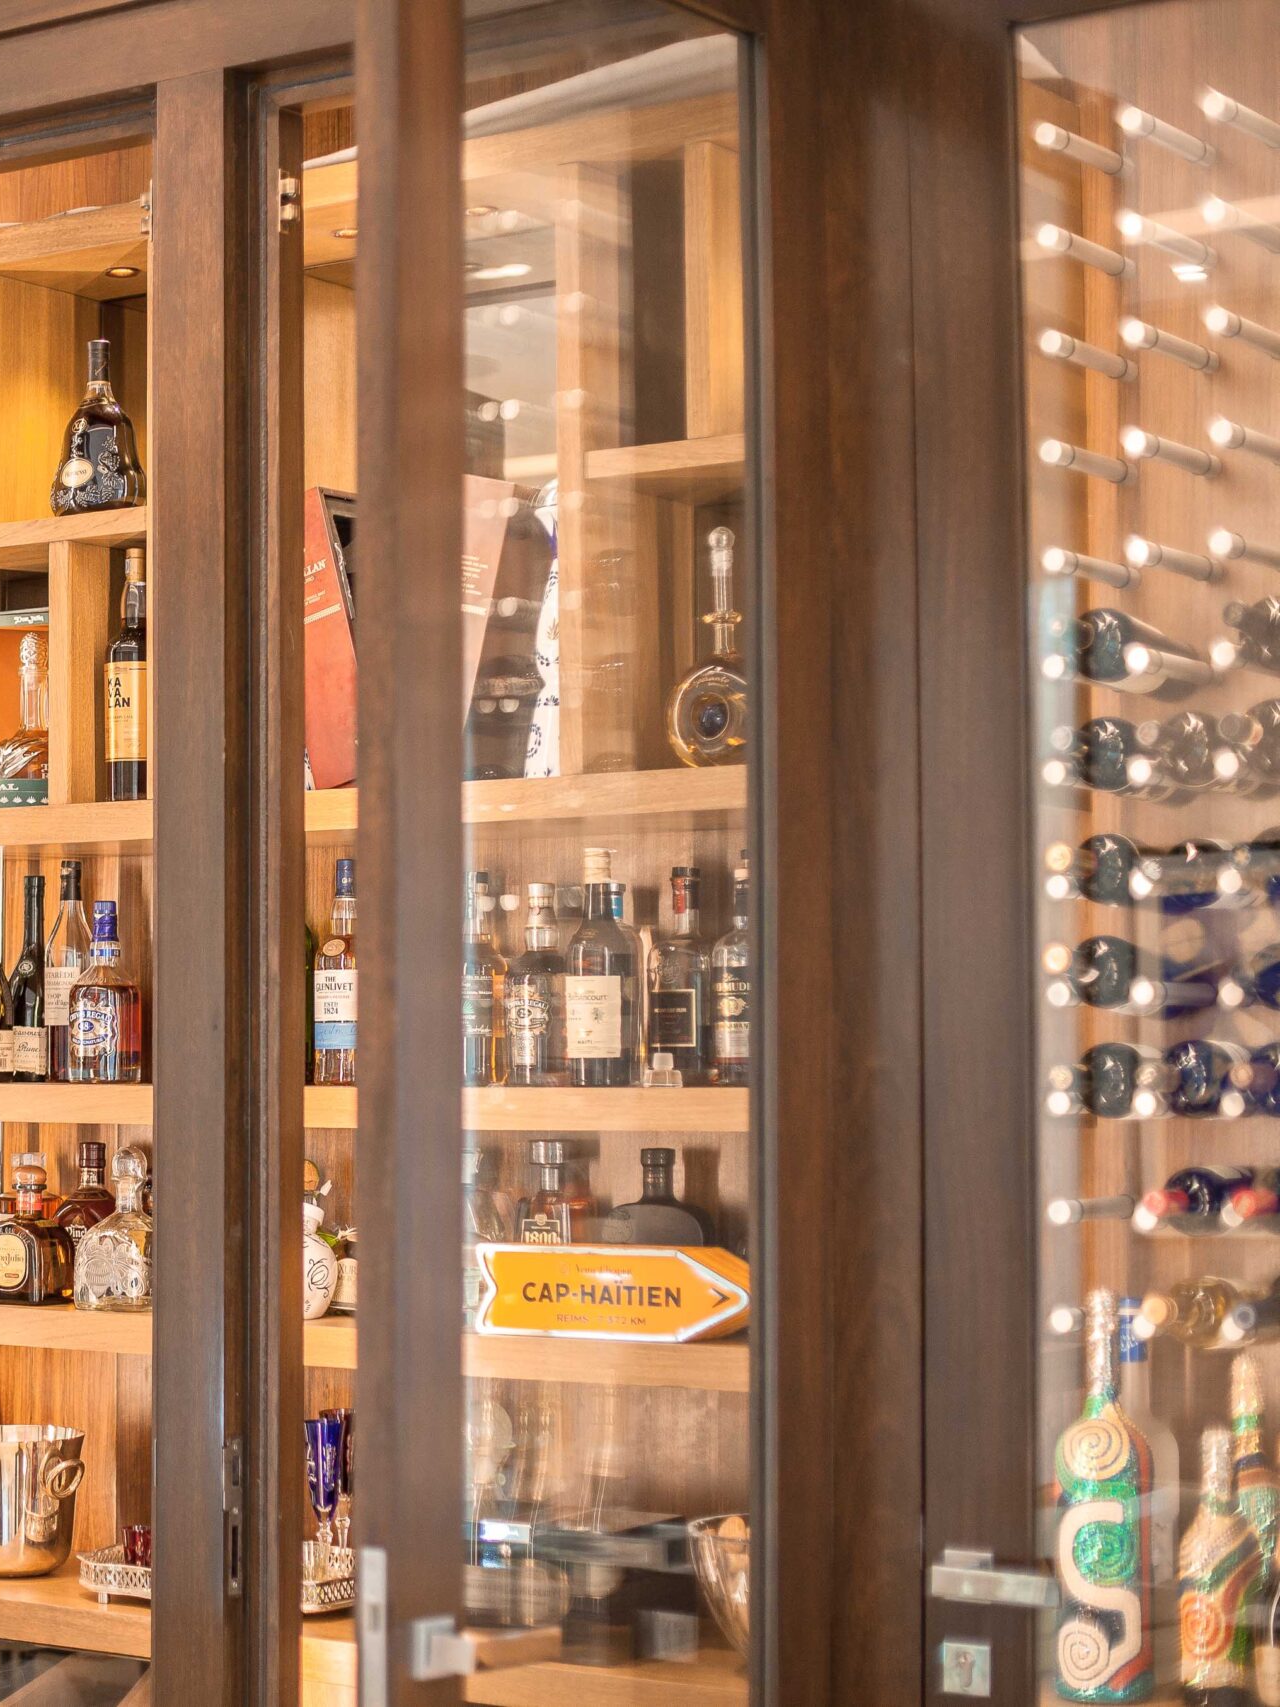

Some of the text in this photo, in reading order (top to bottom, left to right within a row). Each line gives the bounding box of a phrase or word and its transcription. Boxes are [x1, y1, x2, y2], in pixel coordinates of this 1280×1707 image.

[108, 677, 122, 687] KA
[108, 688, 122, 698] VA
[108, 697, 131, 708] LAN
[316, 982, 353, 992] GLENLIVET
[522, 1279, 682, 1308] CAP-HAÏTIEN
[557, 1313, 589, 1323] REIMS
[631, 1317, 646, 1326] KM
